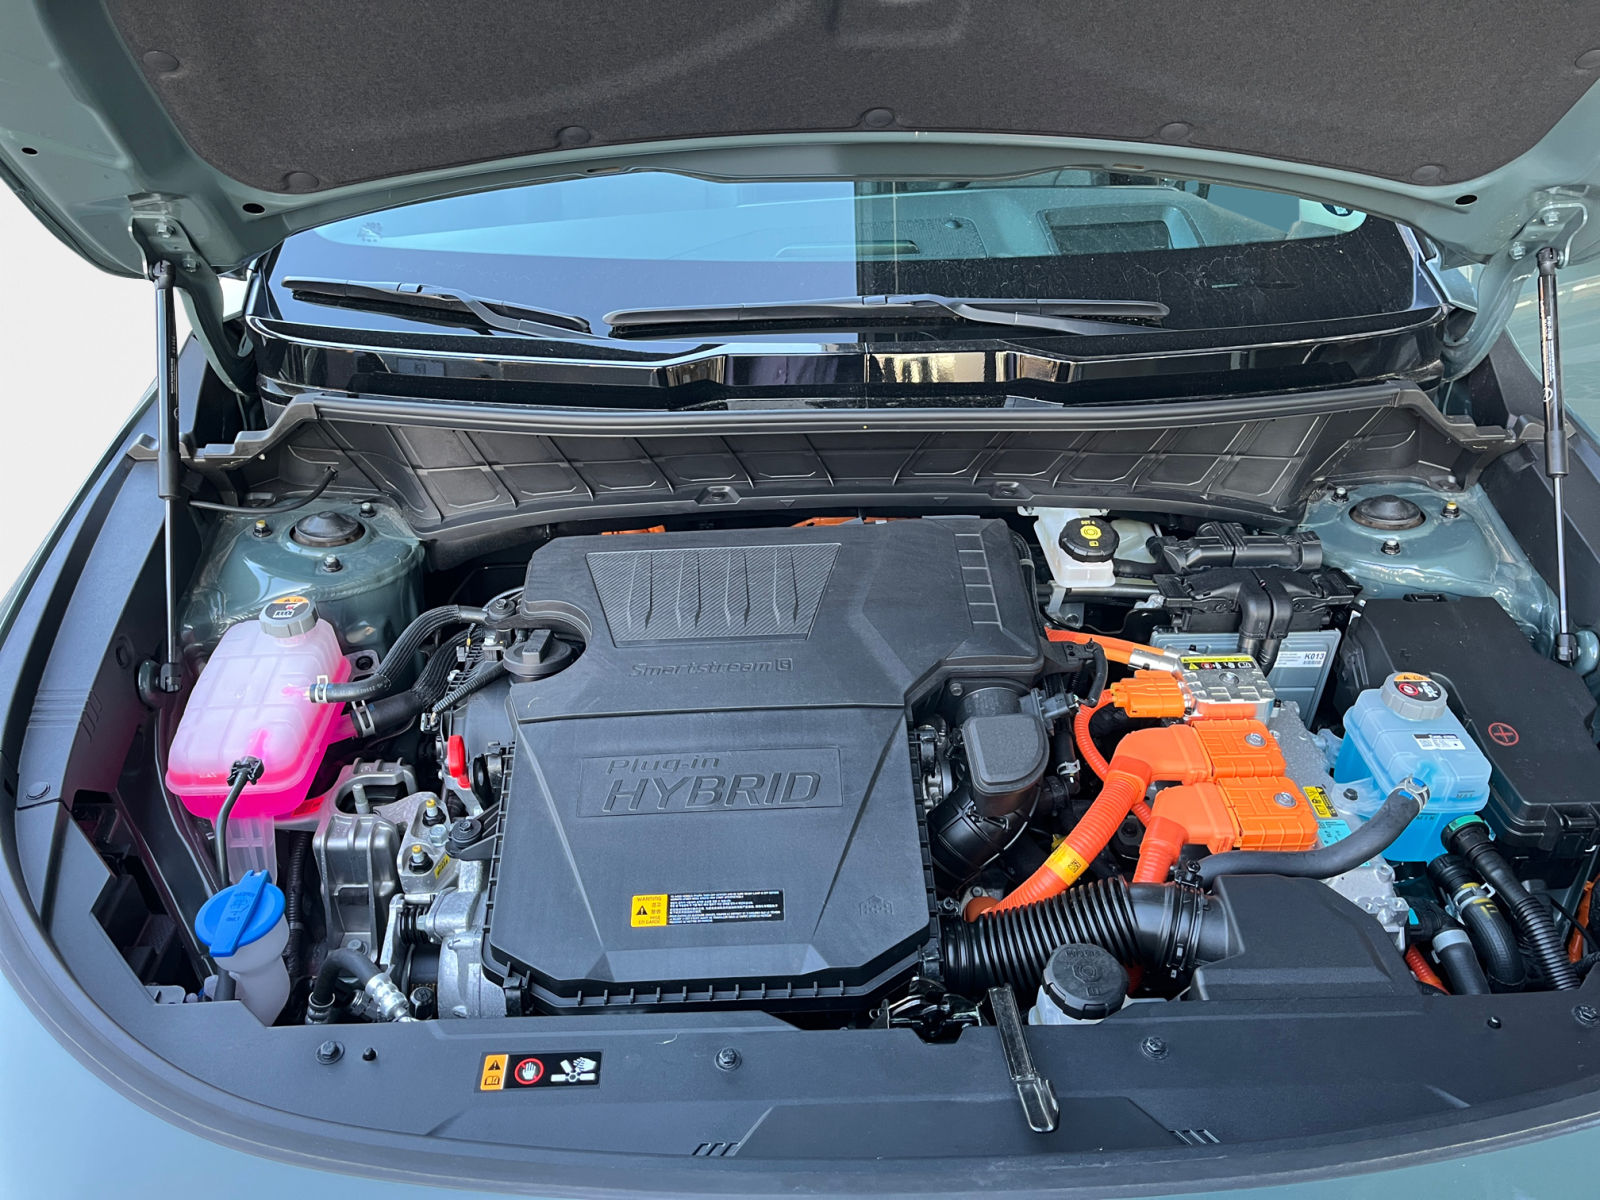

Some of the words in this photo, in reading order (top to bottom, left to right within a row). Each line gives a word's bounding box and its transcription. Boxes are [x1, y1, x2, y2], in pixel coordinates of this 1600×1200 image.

[1304, 652, 1325, 660] K013
[628, 660, 773, 677] Smartstream
[605, 755, 720, 775] Plug-in
[602, 771, 821, 812] HYBRID
